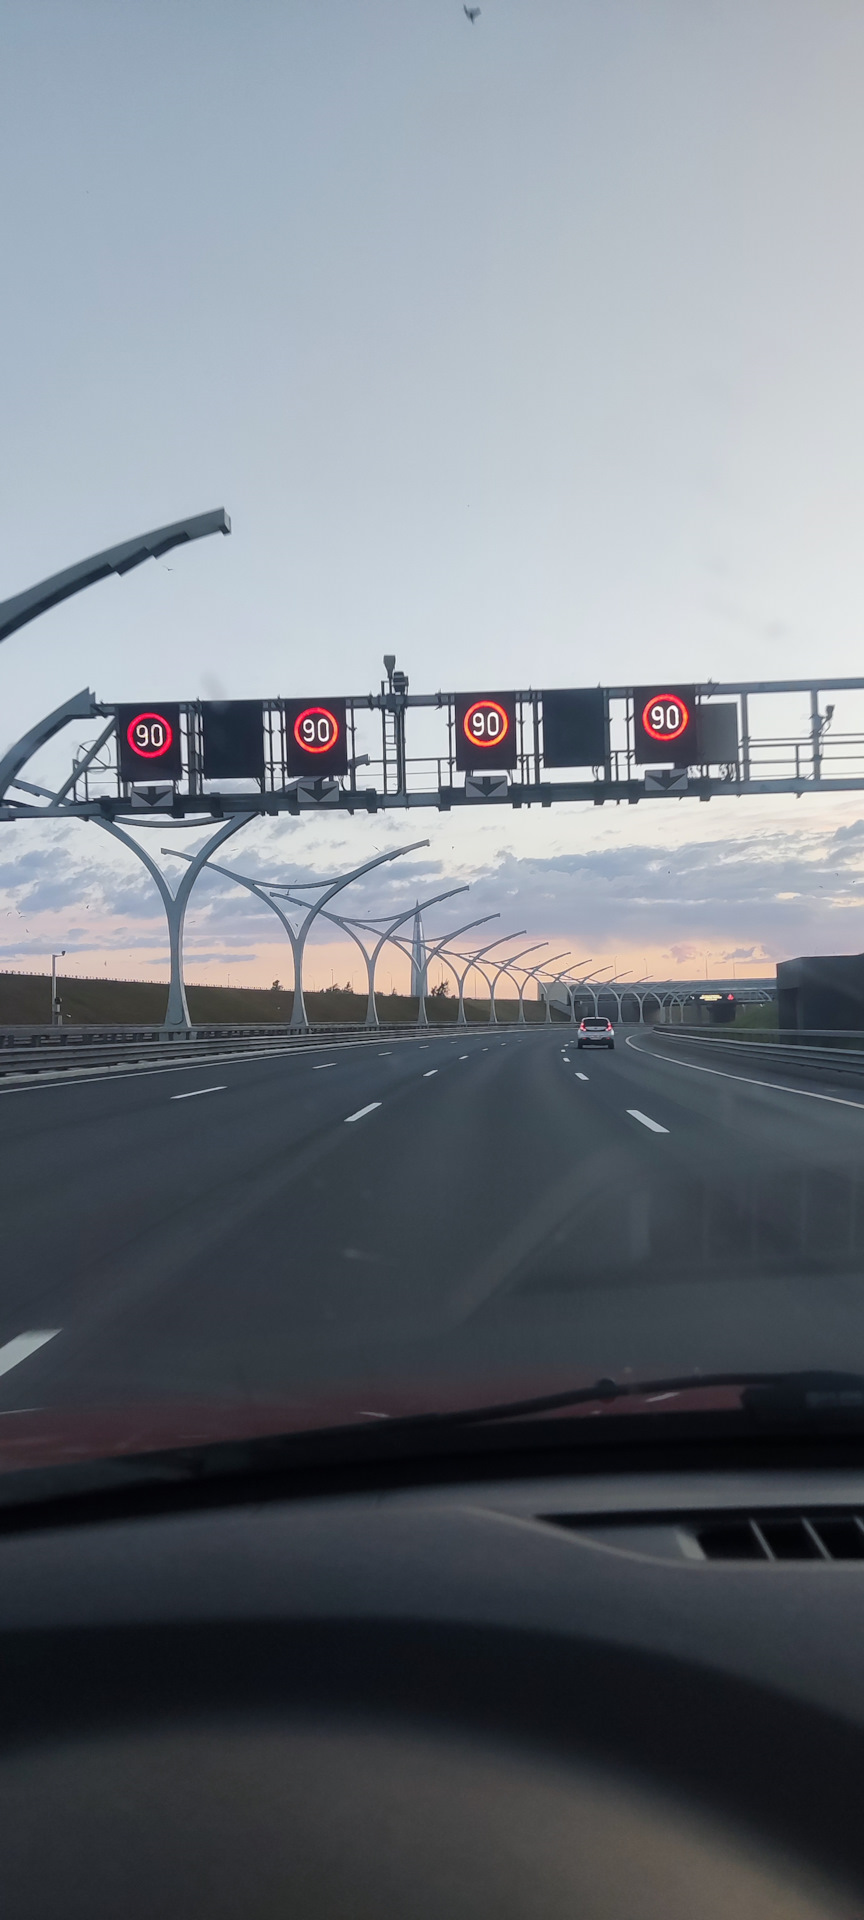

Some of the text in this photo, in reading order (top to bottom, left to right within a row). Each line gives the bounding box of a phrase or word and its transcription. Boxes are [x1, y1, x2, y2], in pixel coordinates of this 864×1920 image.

[472, 711, 500, 737] 90
[650, 705, 680, 730] 90
[136, 723, 164, 747] 90
[302, 718, 330, 743] 90
